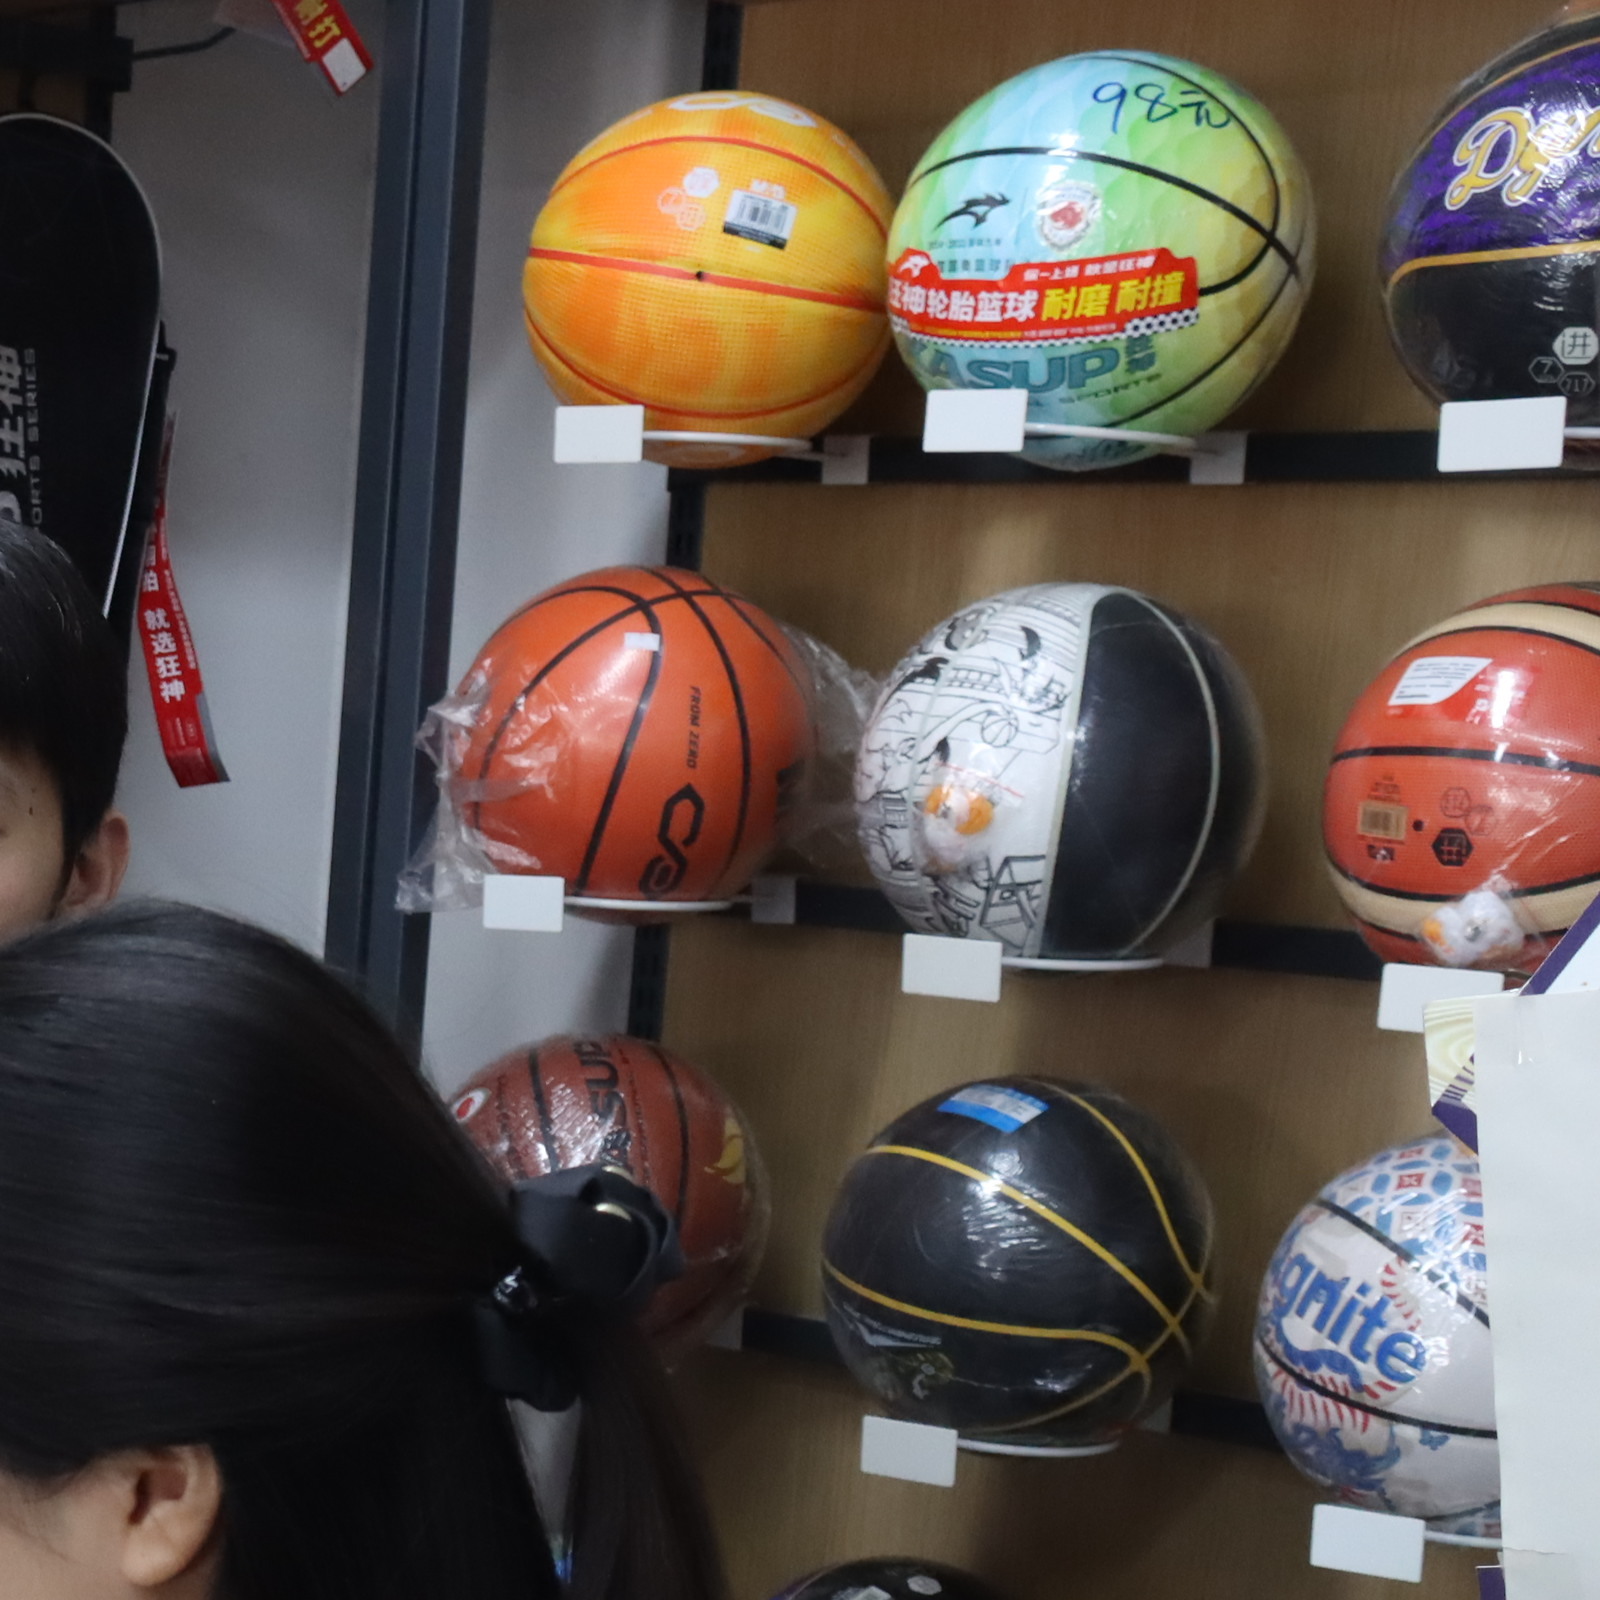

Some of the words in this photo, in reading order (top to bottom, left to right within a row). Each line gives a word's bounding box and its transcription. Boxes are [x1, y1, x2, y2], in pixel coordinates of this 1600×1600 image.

[1092, 82, 1233, 134] 98元
[1041, 284, 1113, 321] 耐磨
[1115, 271, 1186, 314] 耐撞
[23, 348, 41, 442] SERIES
[144, 608, 185, 703] 就选狂神
[689, 686, 702, 727] FROM
[686, 731, 700, 770] ZERO
